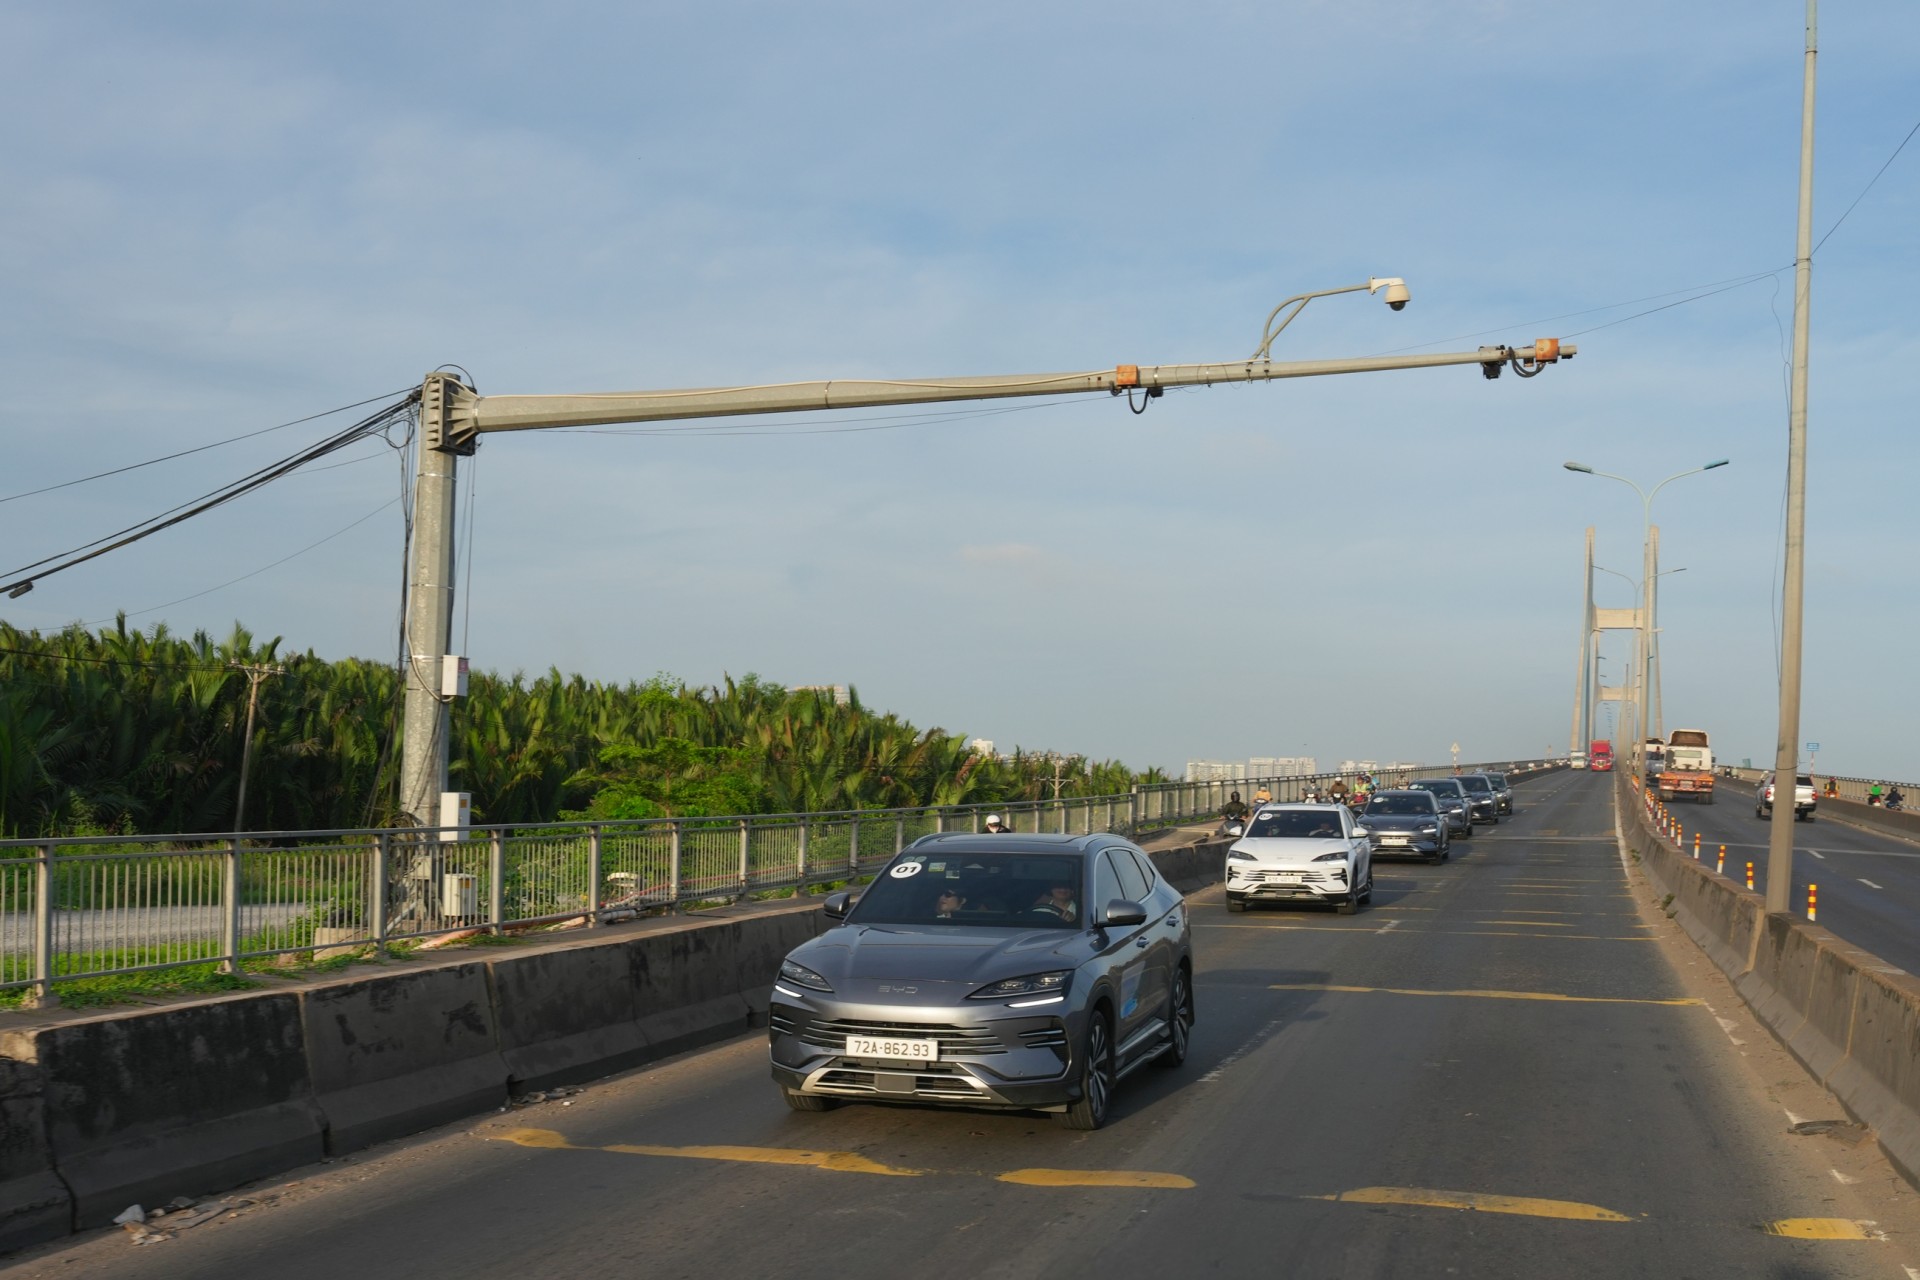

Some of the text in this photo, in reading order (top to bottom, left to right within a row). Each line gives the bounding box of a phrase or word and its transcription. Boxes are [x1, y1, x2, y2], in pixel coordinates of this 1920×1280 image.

[895, 866, 918, 874] 01
[879, 985, 918, 994] BYD
[854, 1040, 929, 1057] 72A-862.93
